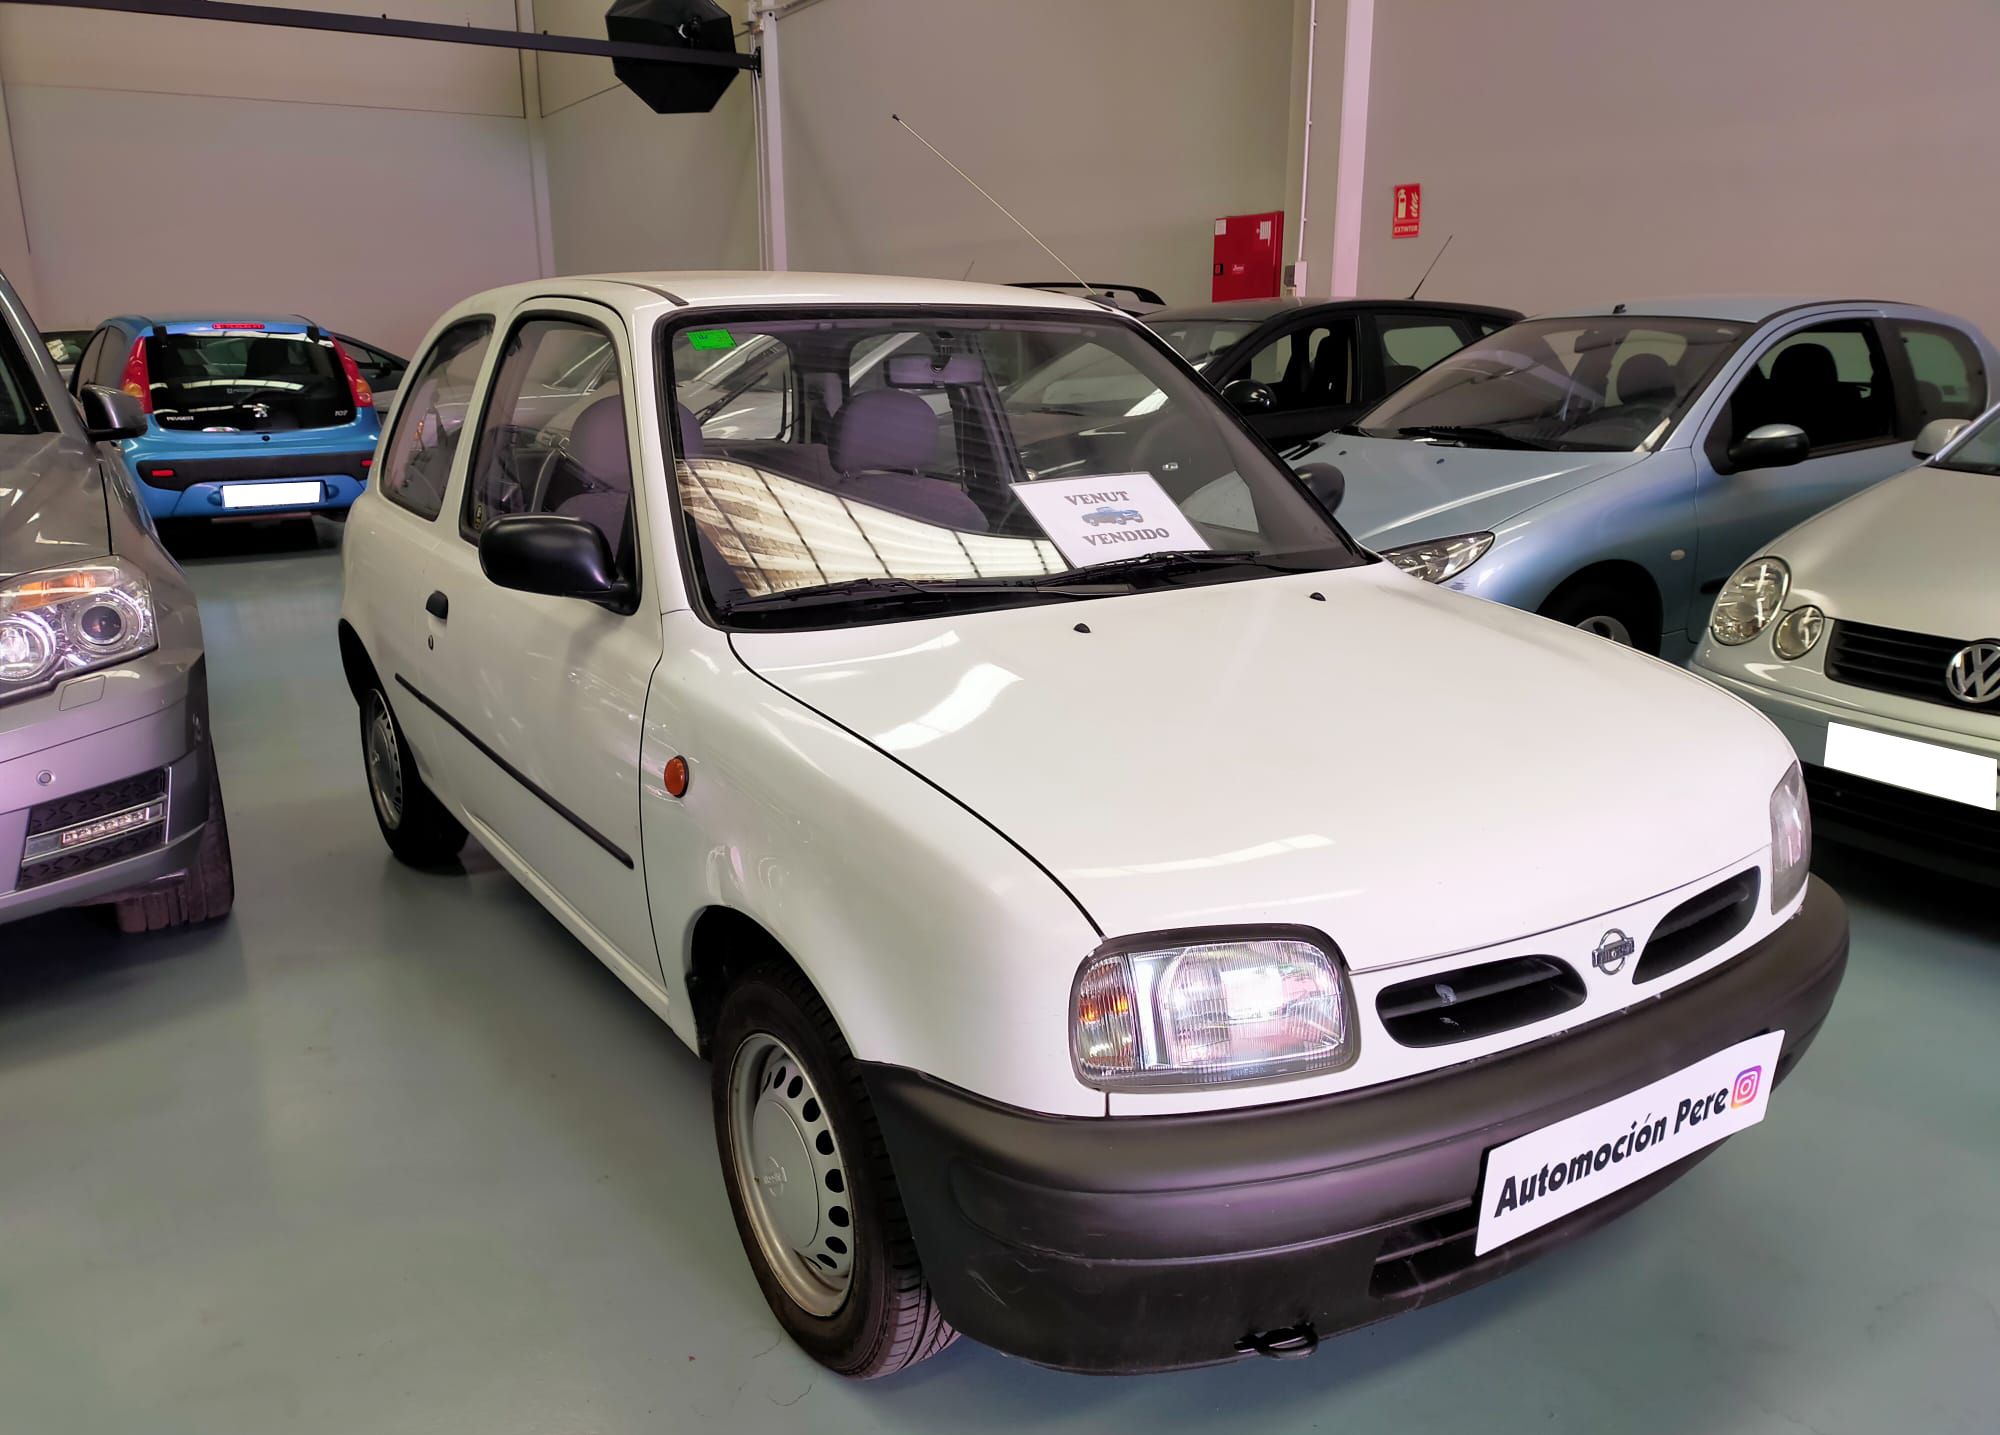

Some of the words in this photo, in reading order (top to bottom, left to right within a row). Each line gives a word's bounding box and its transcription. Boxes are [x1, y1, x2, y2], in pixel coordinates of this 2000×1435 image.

[1064, 490, 1130, 506] VENUT
[1082, 527, 1170, 546] VENDIDO
[1494, 1113, 1667, 1218] Automoción
[1674, 1087, 1729, 1135] Pere
